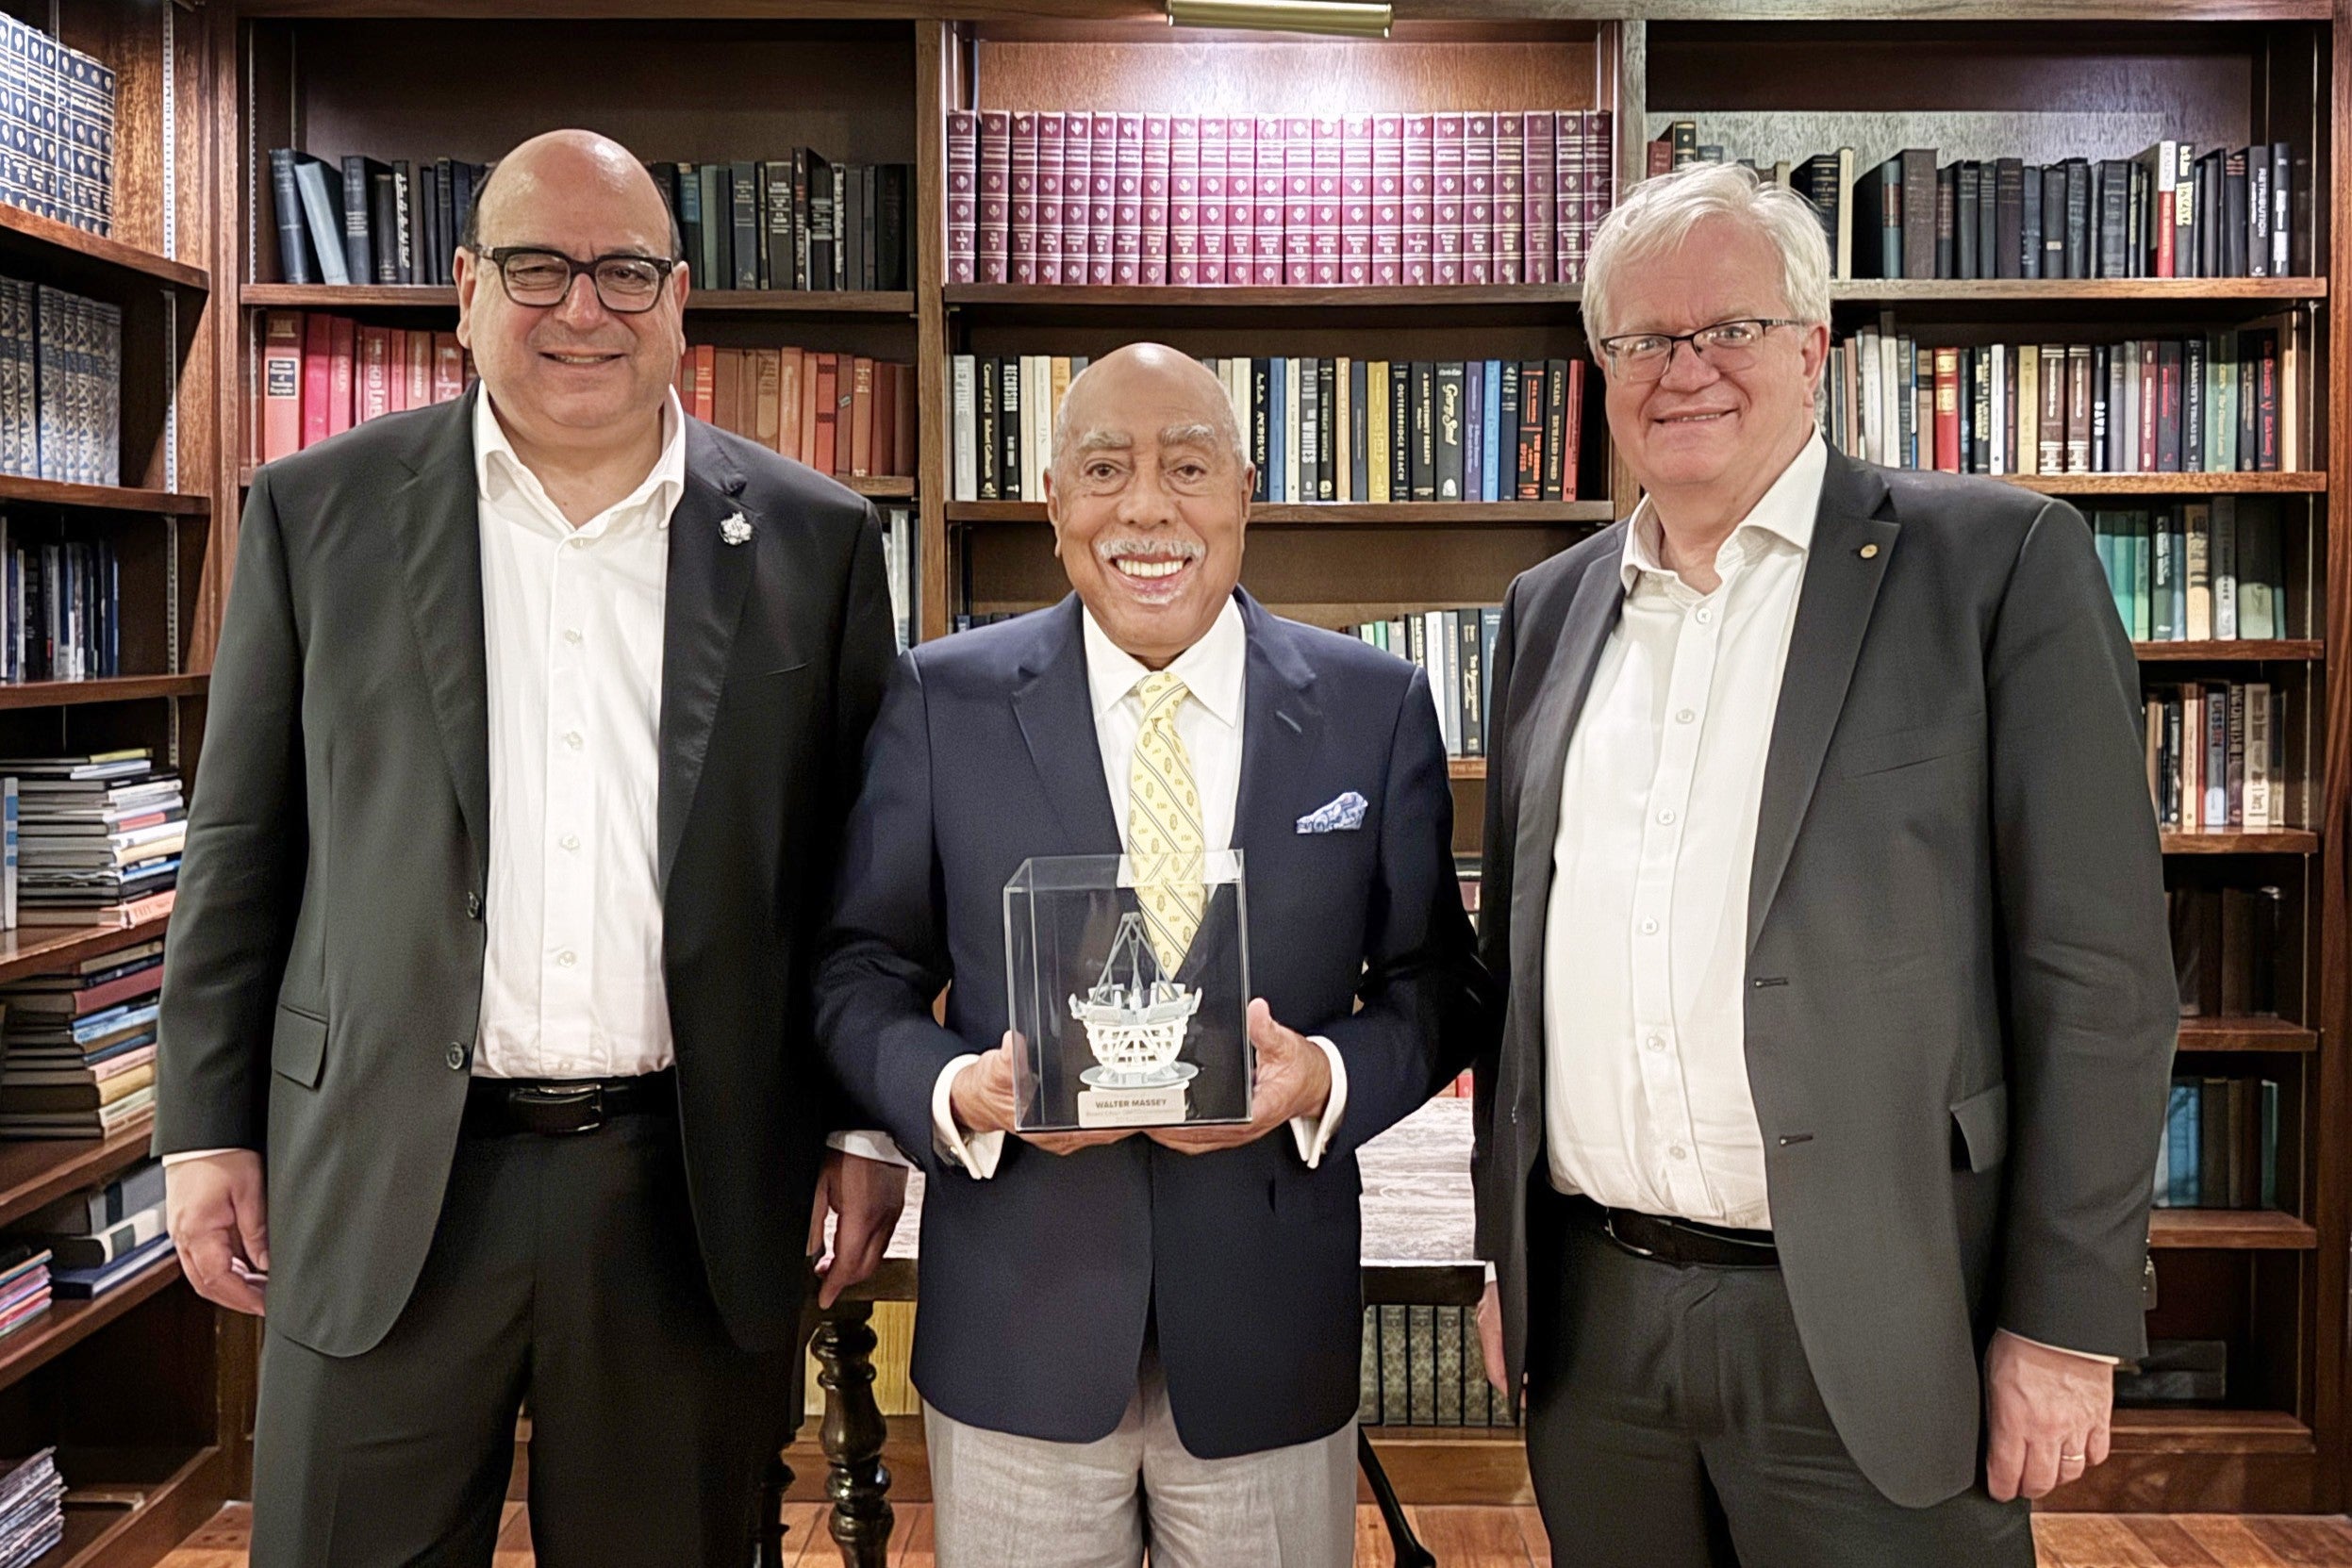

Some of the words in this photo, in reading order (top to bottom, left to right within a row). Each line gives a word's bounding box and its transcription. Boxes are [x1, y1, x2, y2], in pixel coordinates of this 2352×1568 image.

[2258, 167, 2267, 238] RETRIBUTION
[984, 363, 992, 388] Career
[1003, 364, 1018, 411] RECURSION
[984, 388, 992, 397] of
[984, 399, 992, 413] Evil
[1301, 421, 1317, 464] WHITES
[1550, 415, 1560, 454] RICHARD
[1549, 455, 1559, 480] FORD
[1095, 1099, 1130, 1109] WALTER
[1132, 1098, 1167, 1107] MASSEY
